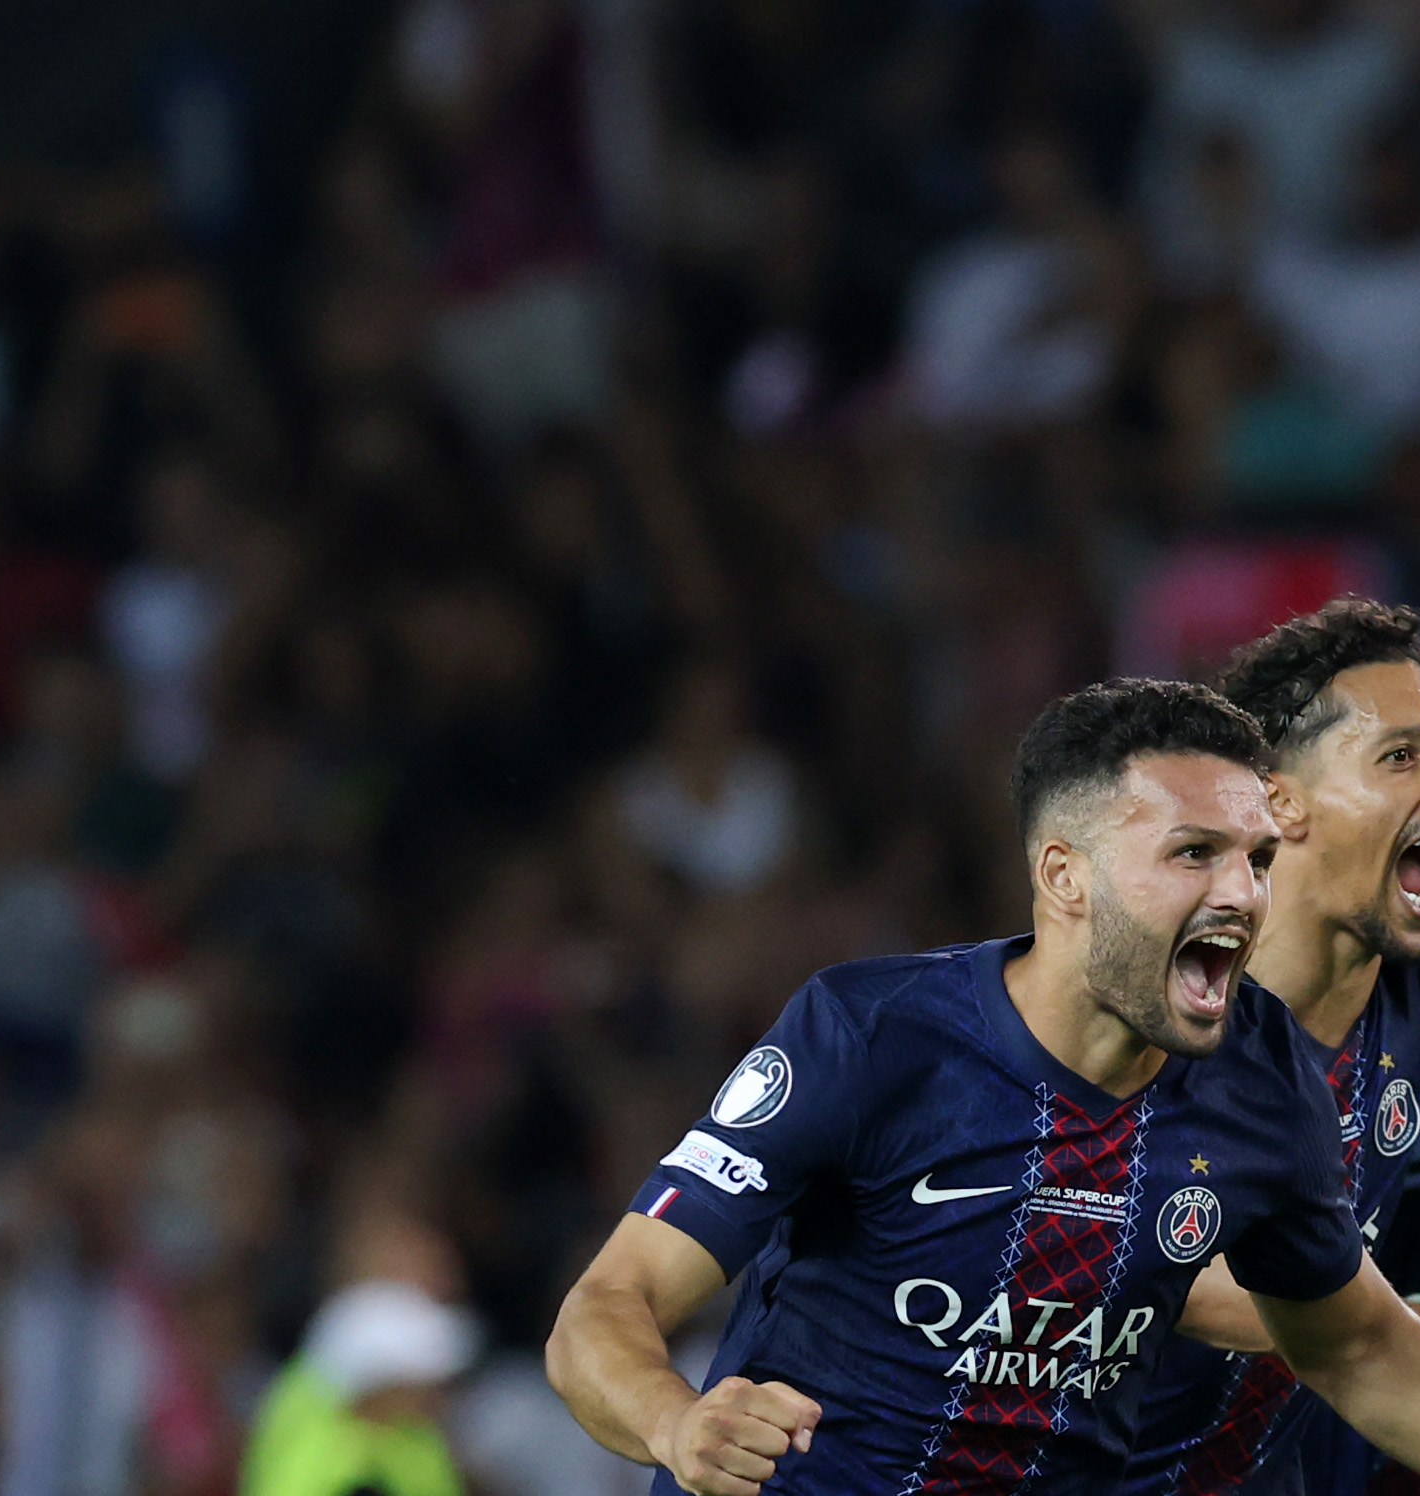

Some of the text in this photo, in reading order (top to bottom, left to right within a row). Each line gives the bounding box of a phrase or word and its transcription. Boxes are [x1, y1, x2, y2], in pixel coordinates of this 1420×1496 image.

[1380, 1083, 1407, 1112] PARIS
[1339, 1113, 1354, 1127] UP
[1033, 1186, 1061, 1198] UEFA
[1173, 1190, 1215, 1211] PARIS
[894, 1278, 1154, 1361] QATAR
[943, 1346, 1129, 1399] AIRWAYS
